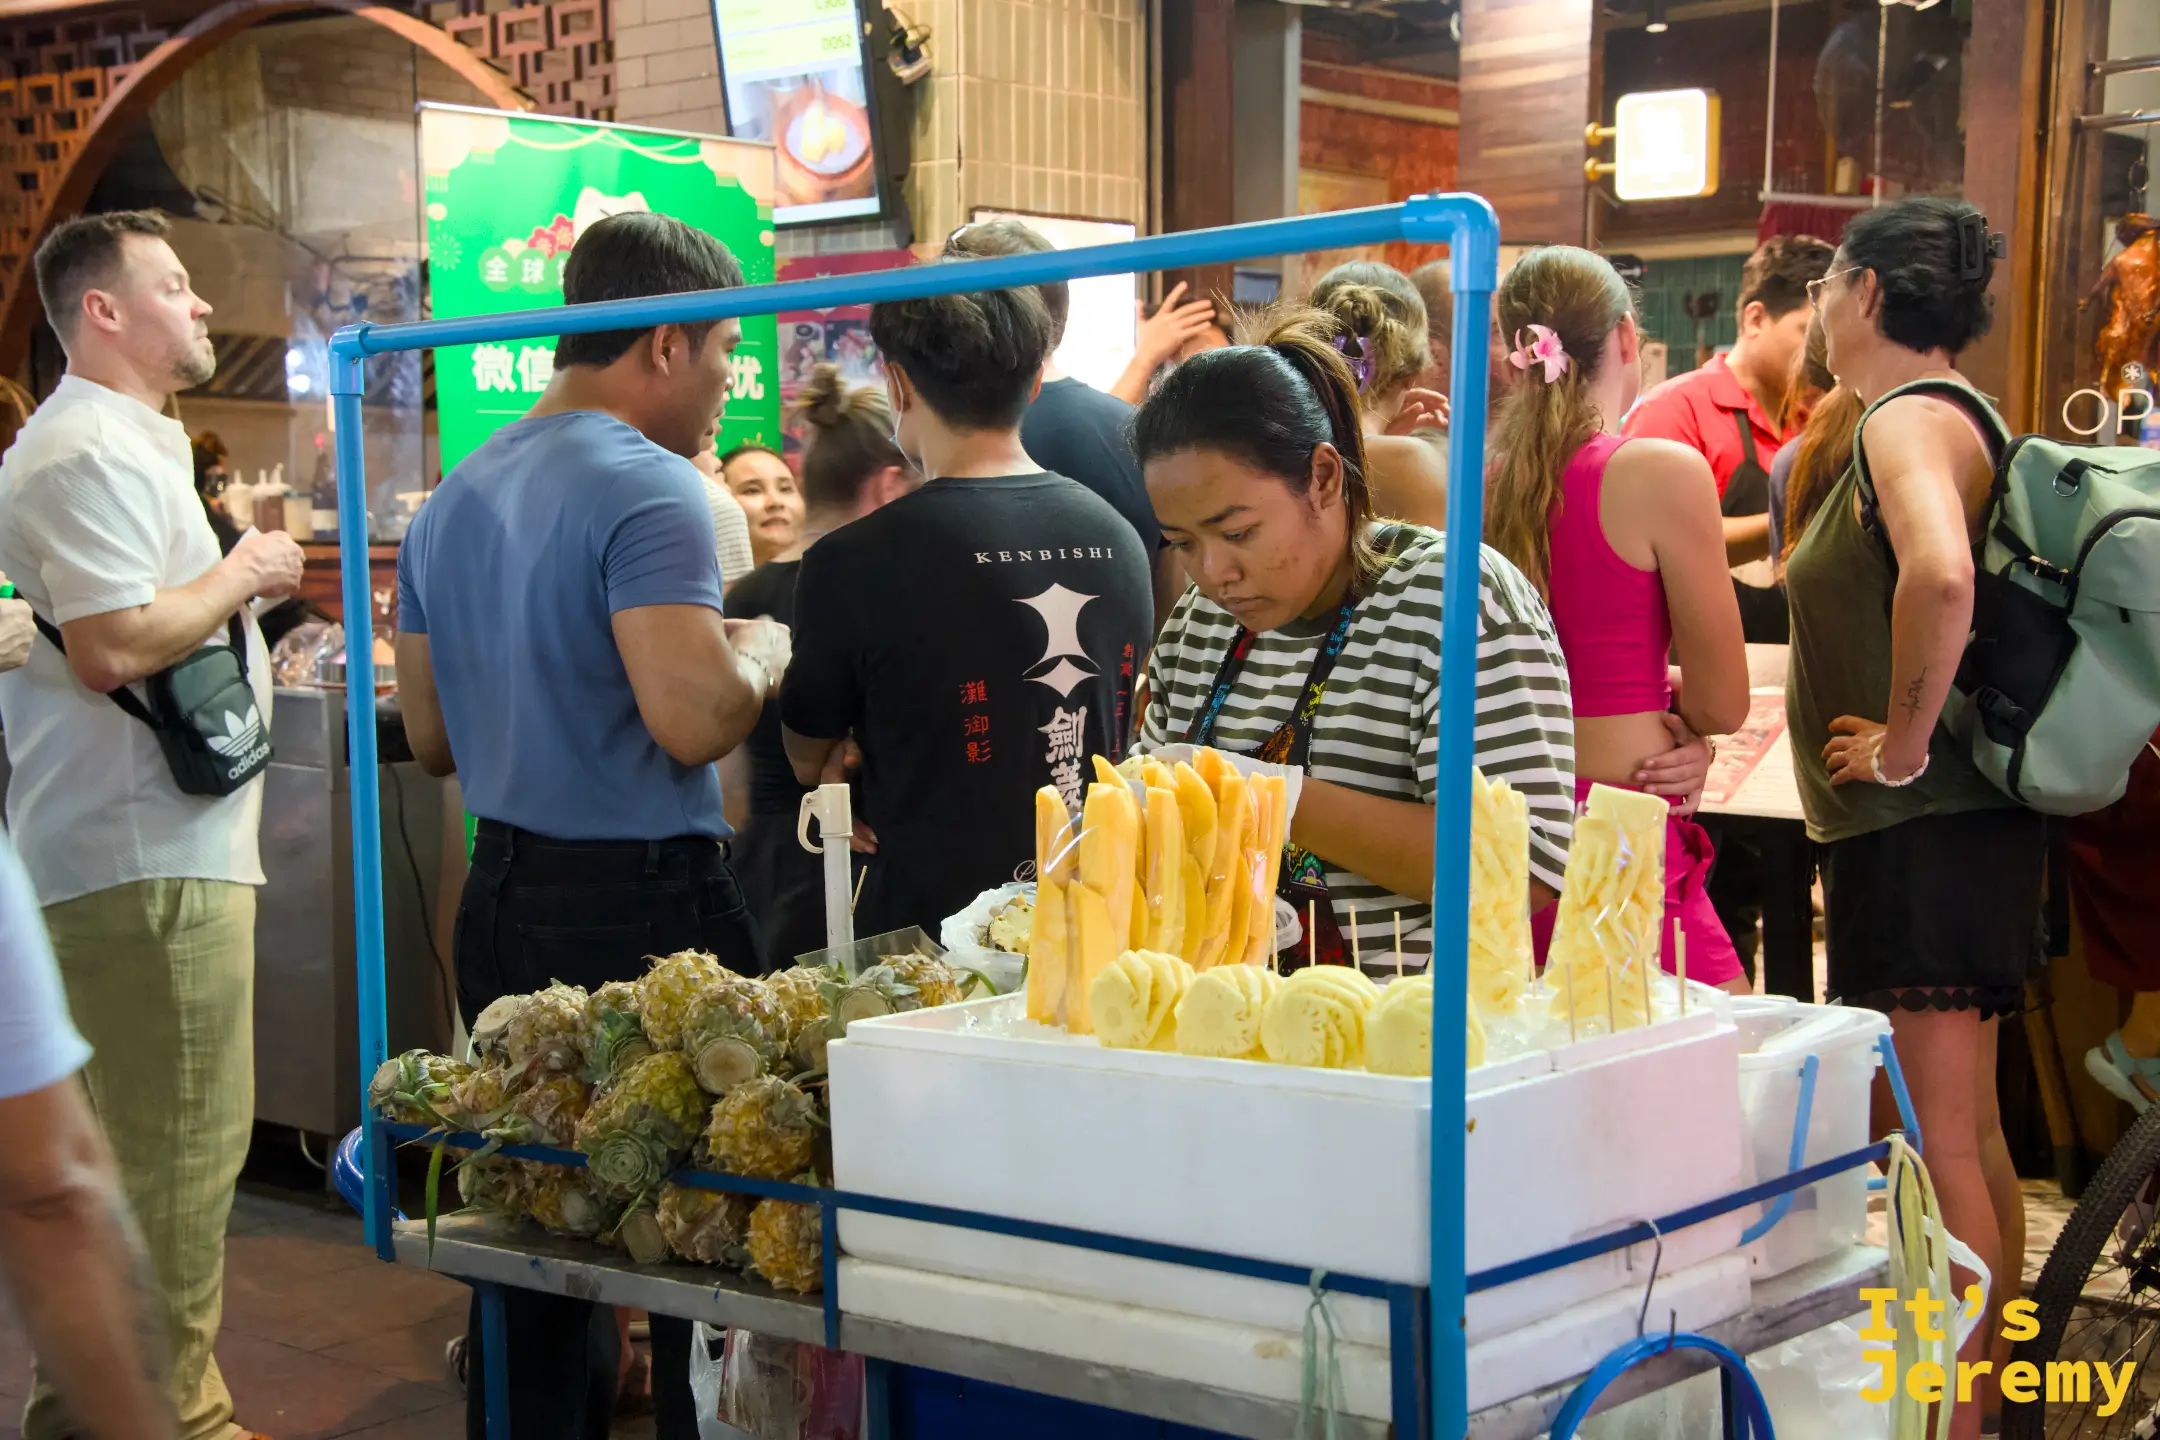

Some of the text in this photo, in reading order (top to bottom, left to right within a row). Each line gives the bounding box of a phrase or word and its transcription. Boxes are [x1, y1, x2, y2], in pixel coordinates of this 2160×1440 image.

[471, 343, 556, 393] 微信
[2062, 388, 2154, 436] OP
[974, 546, 1113, 564] KENBISHI
[228, 742, 270, 779] adidas
